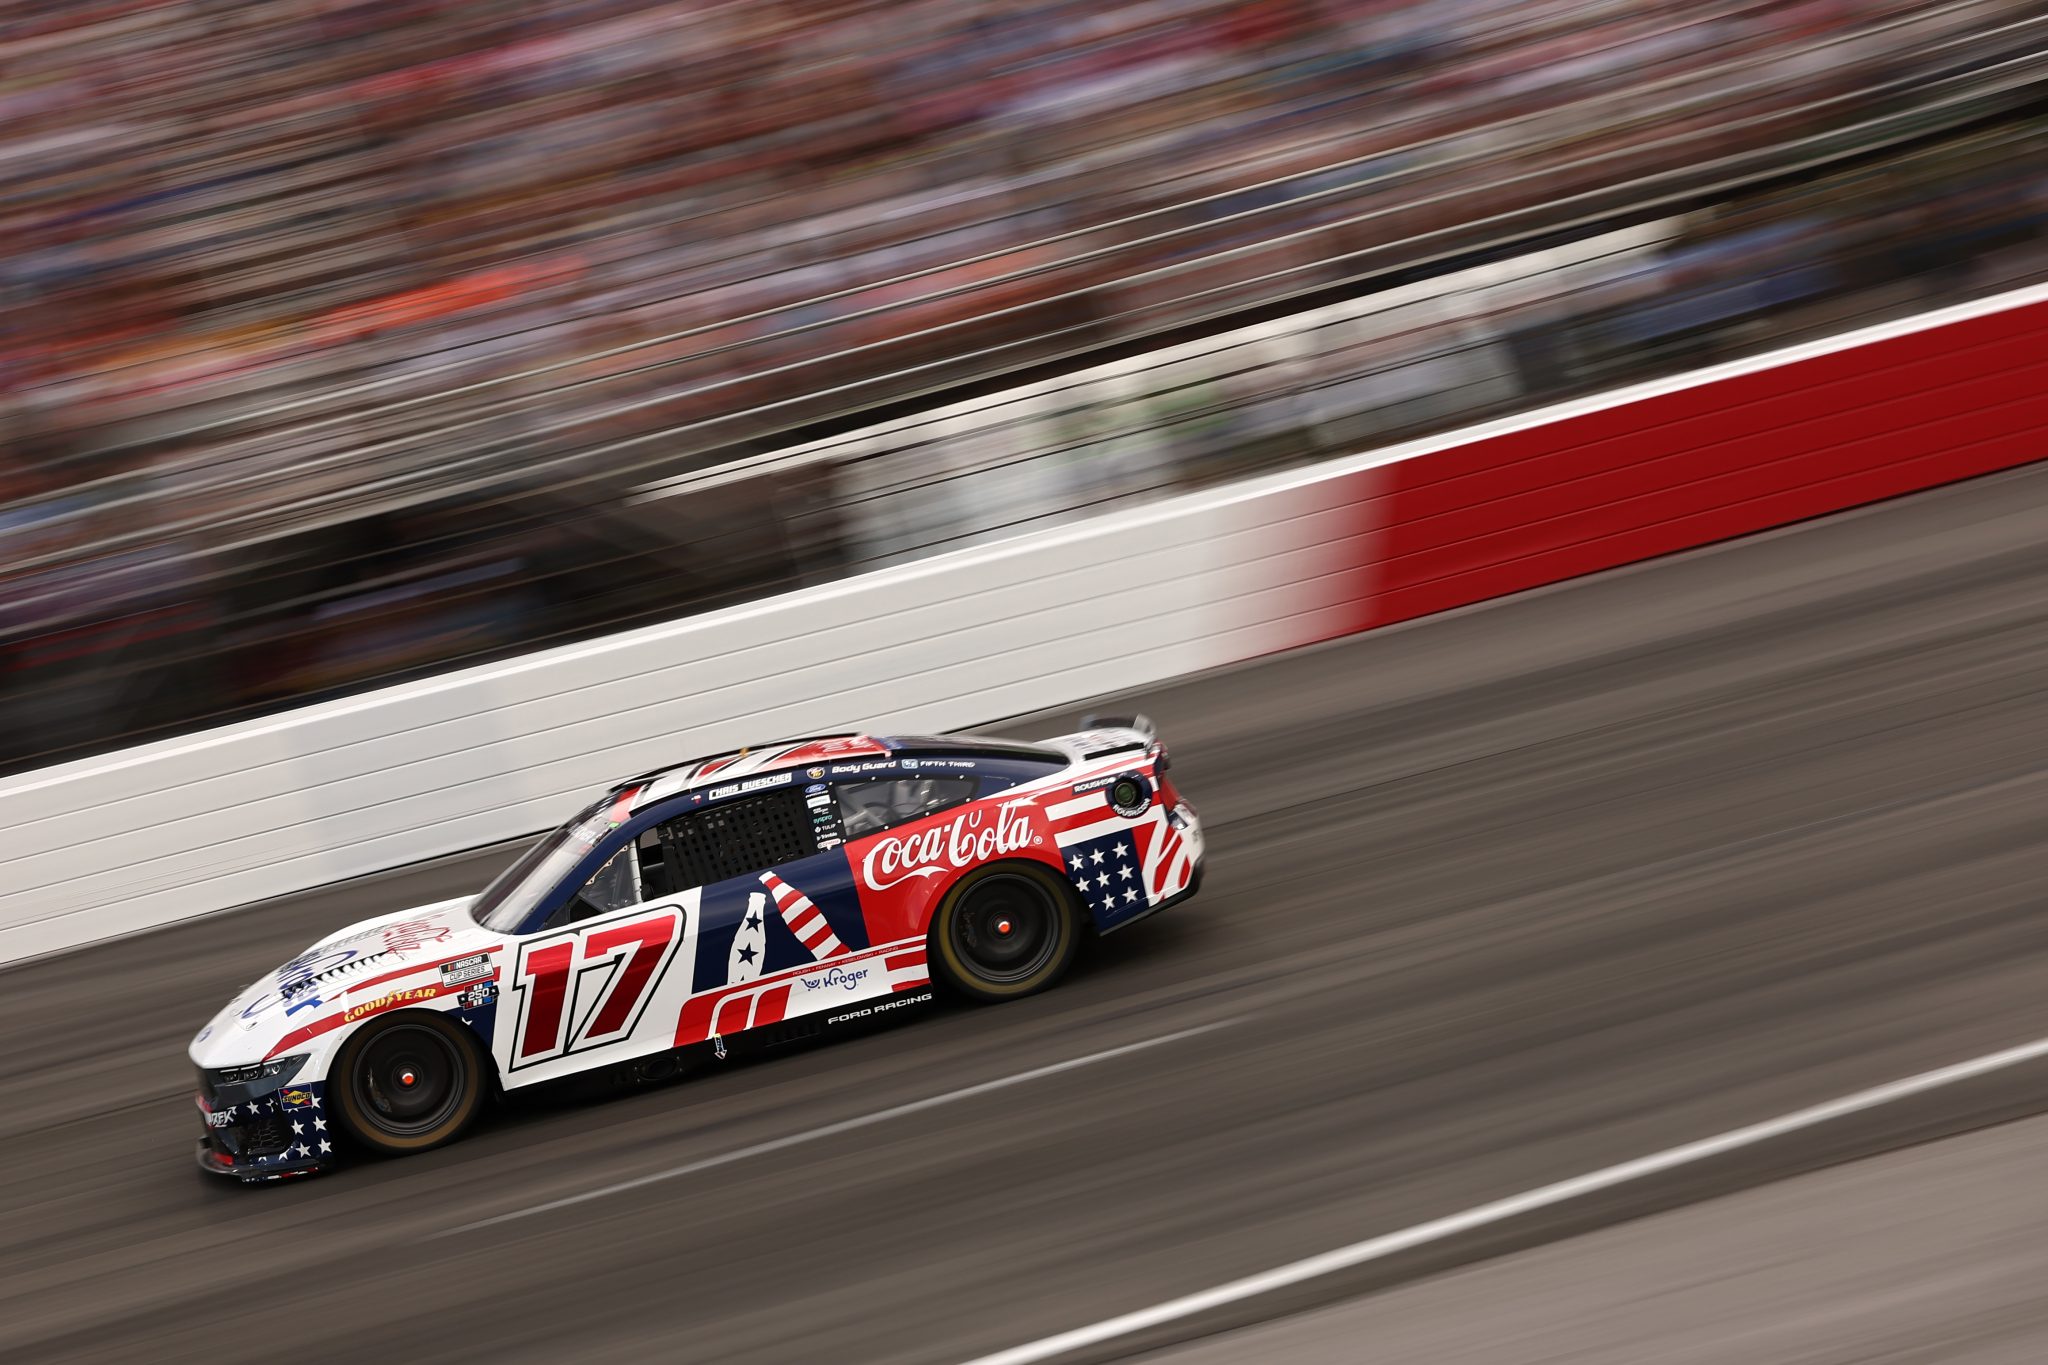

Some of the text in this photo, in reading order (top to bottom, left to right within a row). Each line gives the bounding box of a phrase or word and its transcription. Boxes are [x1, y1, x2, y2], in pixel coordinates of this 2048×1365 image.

[832, 764, 861, 774] Body
[862, 760, 896, 770] Guard
[709, 784, 739, 800] CHRIS
[741, 772, 792, 790] BUESCHER
[863, 801, 1034, 891] Coca-Cola
[449, 965, 486, 981] CUP SERIES
[456, 956, 482, 969] NASCAR
[510, 906, 685, 1070] 17
[823, 968, 869, 990] Kroger
[343, 988, 437, 1022] GOODYEAR
[467, 987, 490, 1002] 250
[828, 993, 932, 1025] FORD RACING
[283, 1092, 312, 1103] SUNOCO
